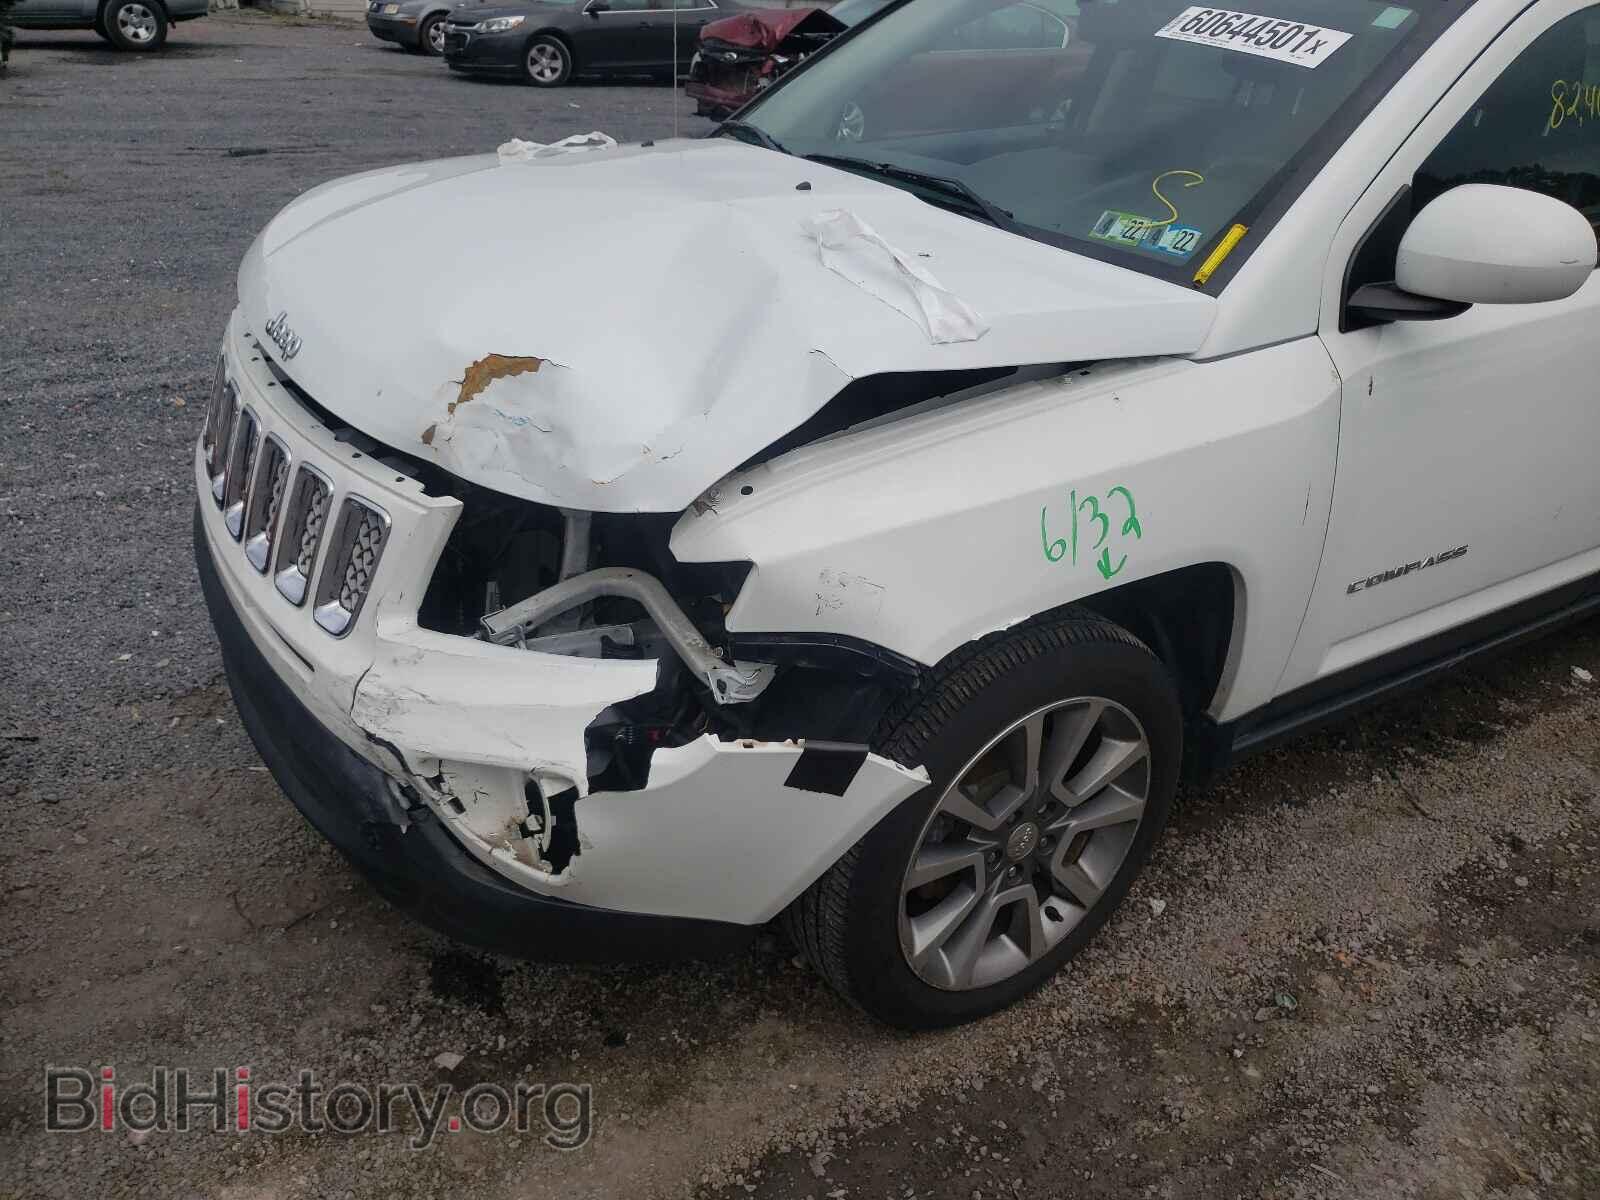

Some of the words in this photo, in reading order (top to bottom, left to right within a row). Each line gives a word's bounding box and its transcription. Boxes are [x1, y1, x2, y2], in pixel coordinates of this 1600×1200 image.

[1172, 230, 1195, 252] 22
[264, 310, 303, 362] Jeep
[1346, 544, 1469, 594] COMPASS
